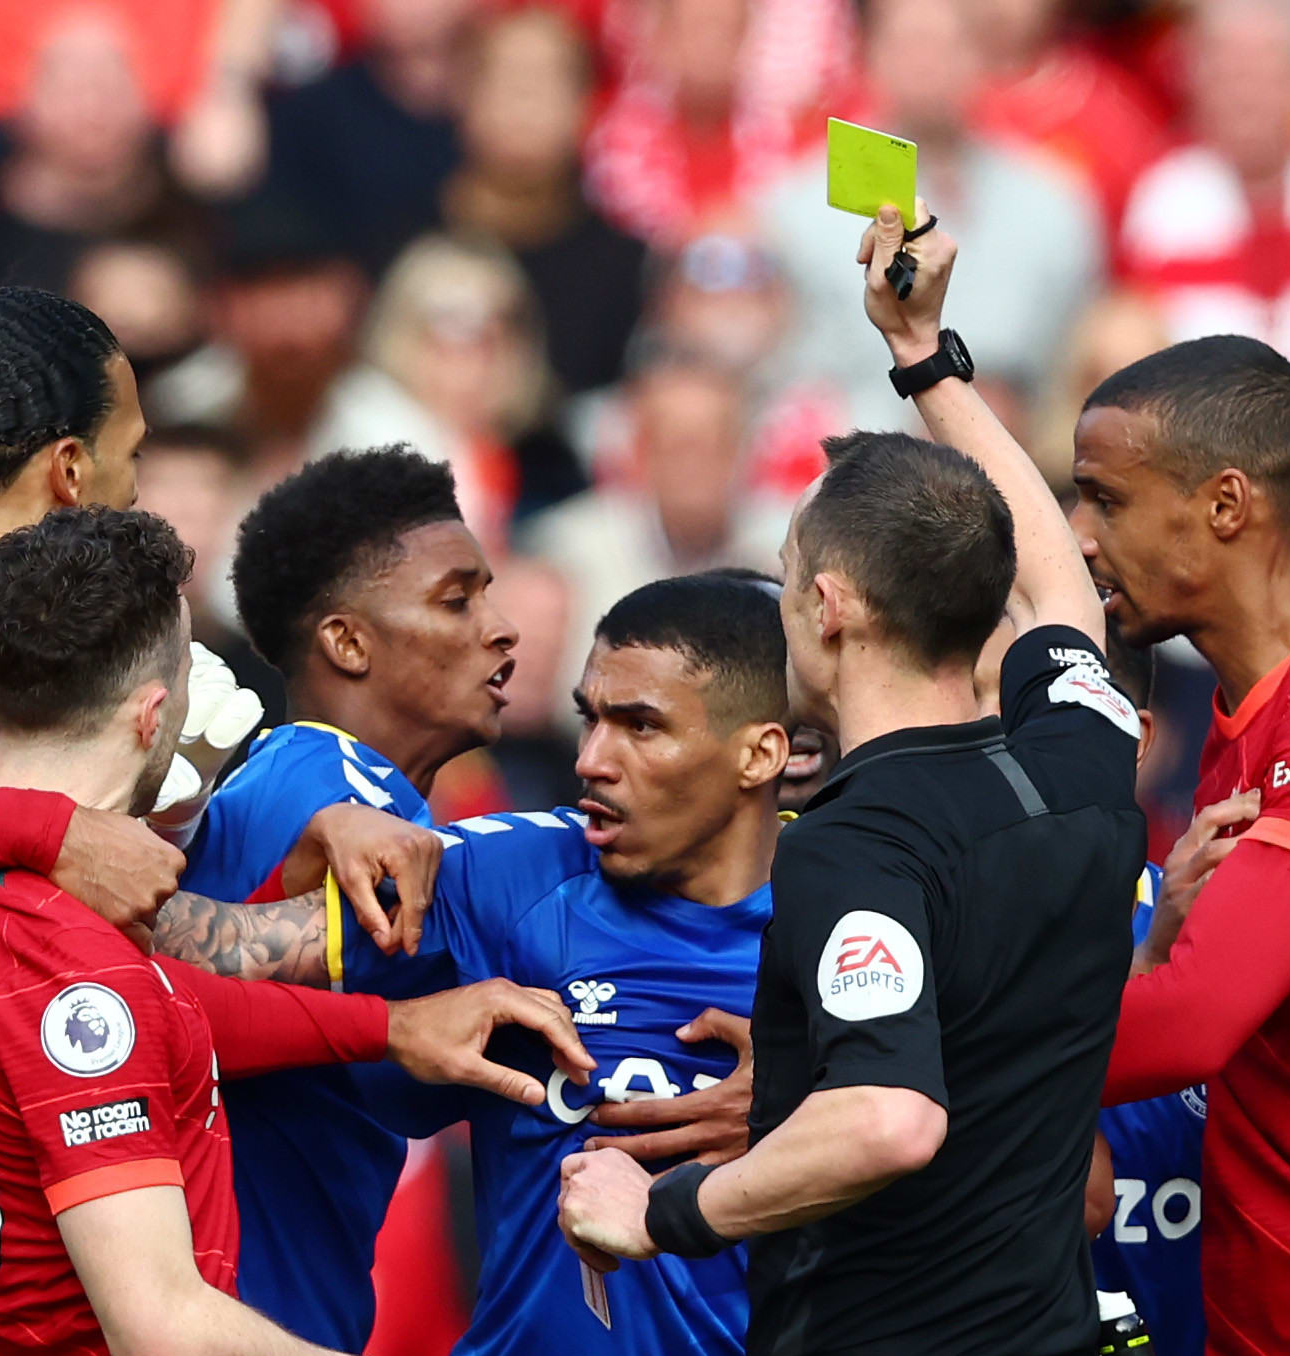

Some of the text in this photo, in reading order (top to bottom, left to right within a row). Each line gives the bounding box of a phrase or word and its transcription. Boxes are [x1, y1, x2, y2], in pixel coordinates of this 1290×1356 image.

[836, 936, 903, 975] EA
[831, 971, 905, 995] SPORTS
[60, 1101, 141, 1131] No room
[63, 1115, 150, 1147] for racism
